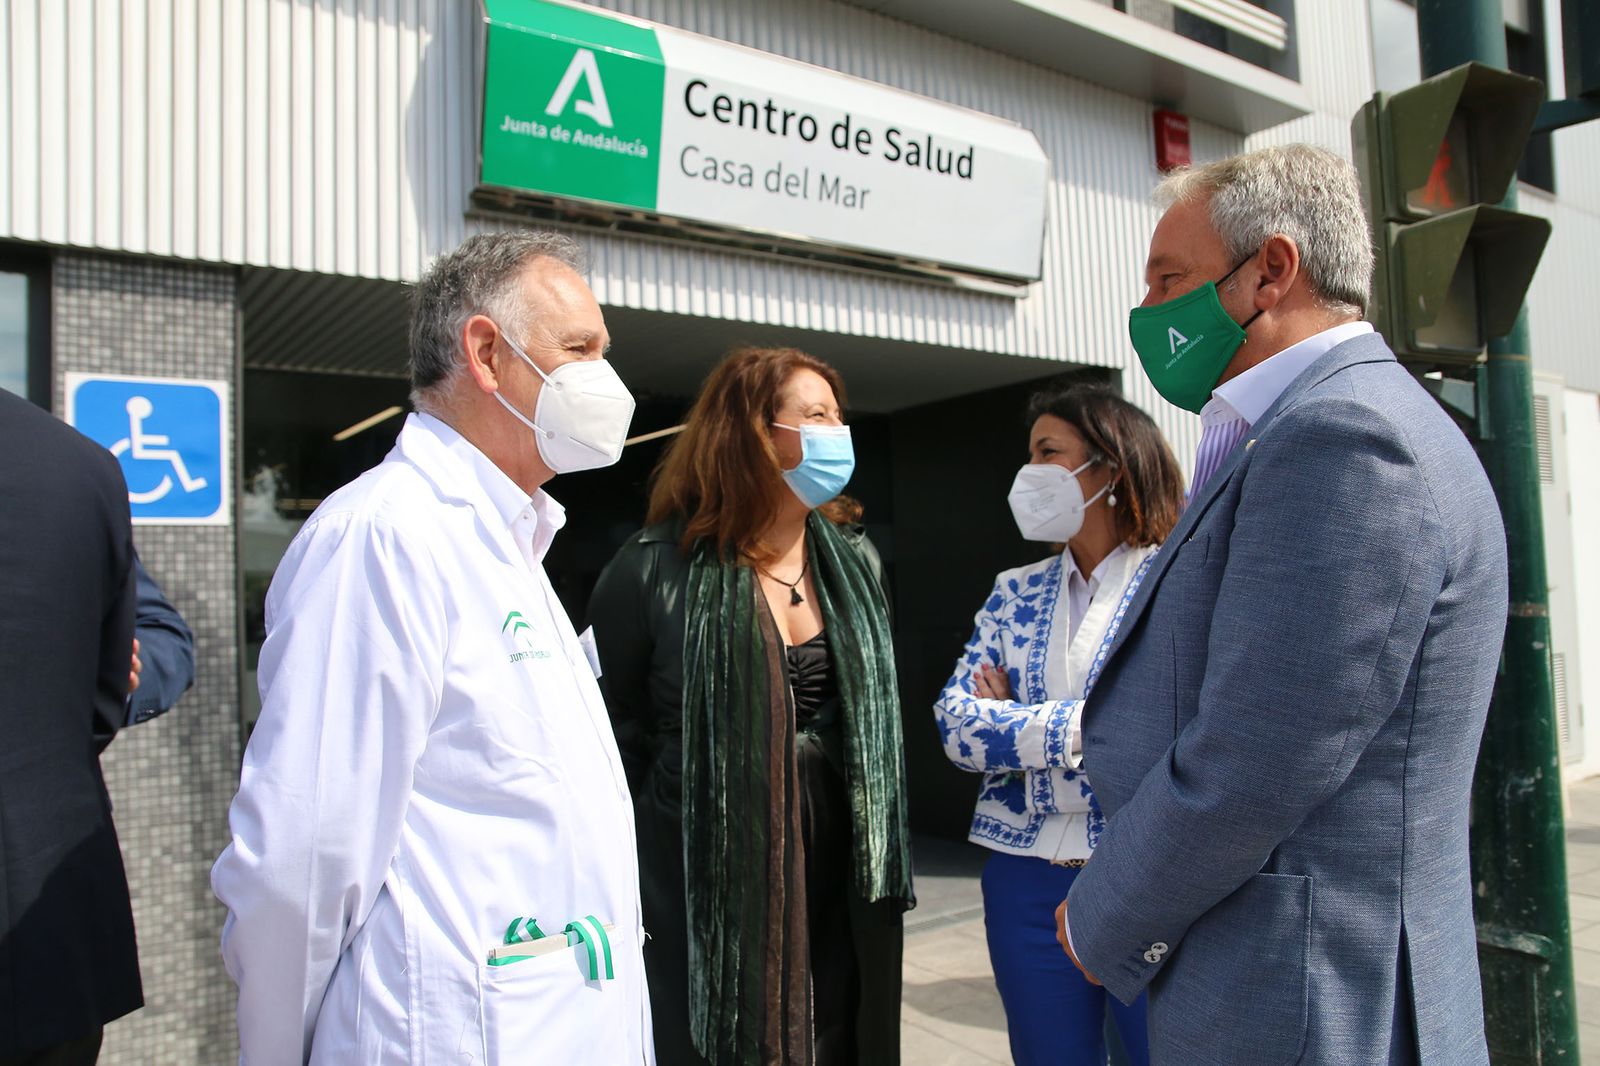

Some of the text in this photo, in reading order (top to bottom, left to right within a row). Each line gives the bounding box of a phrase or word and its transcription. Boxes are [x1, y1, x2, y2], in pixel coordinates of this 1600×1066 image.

[500, 115, 648, 158] Junta de Andalucía
[684, 79, 975, 180] Centro de Salud
[679, 144, 870, 210] Casa del Mar
